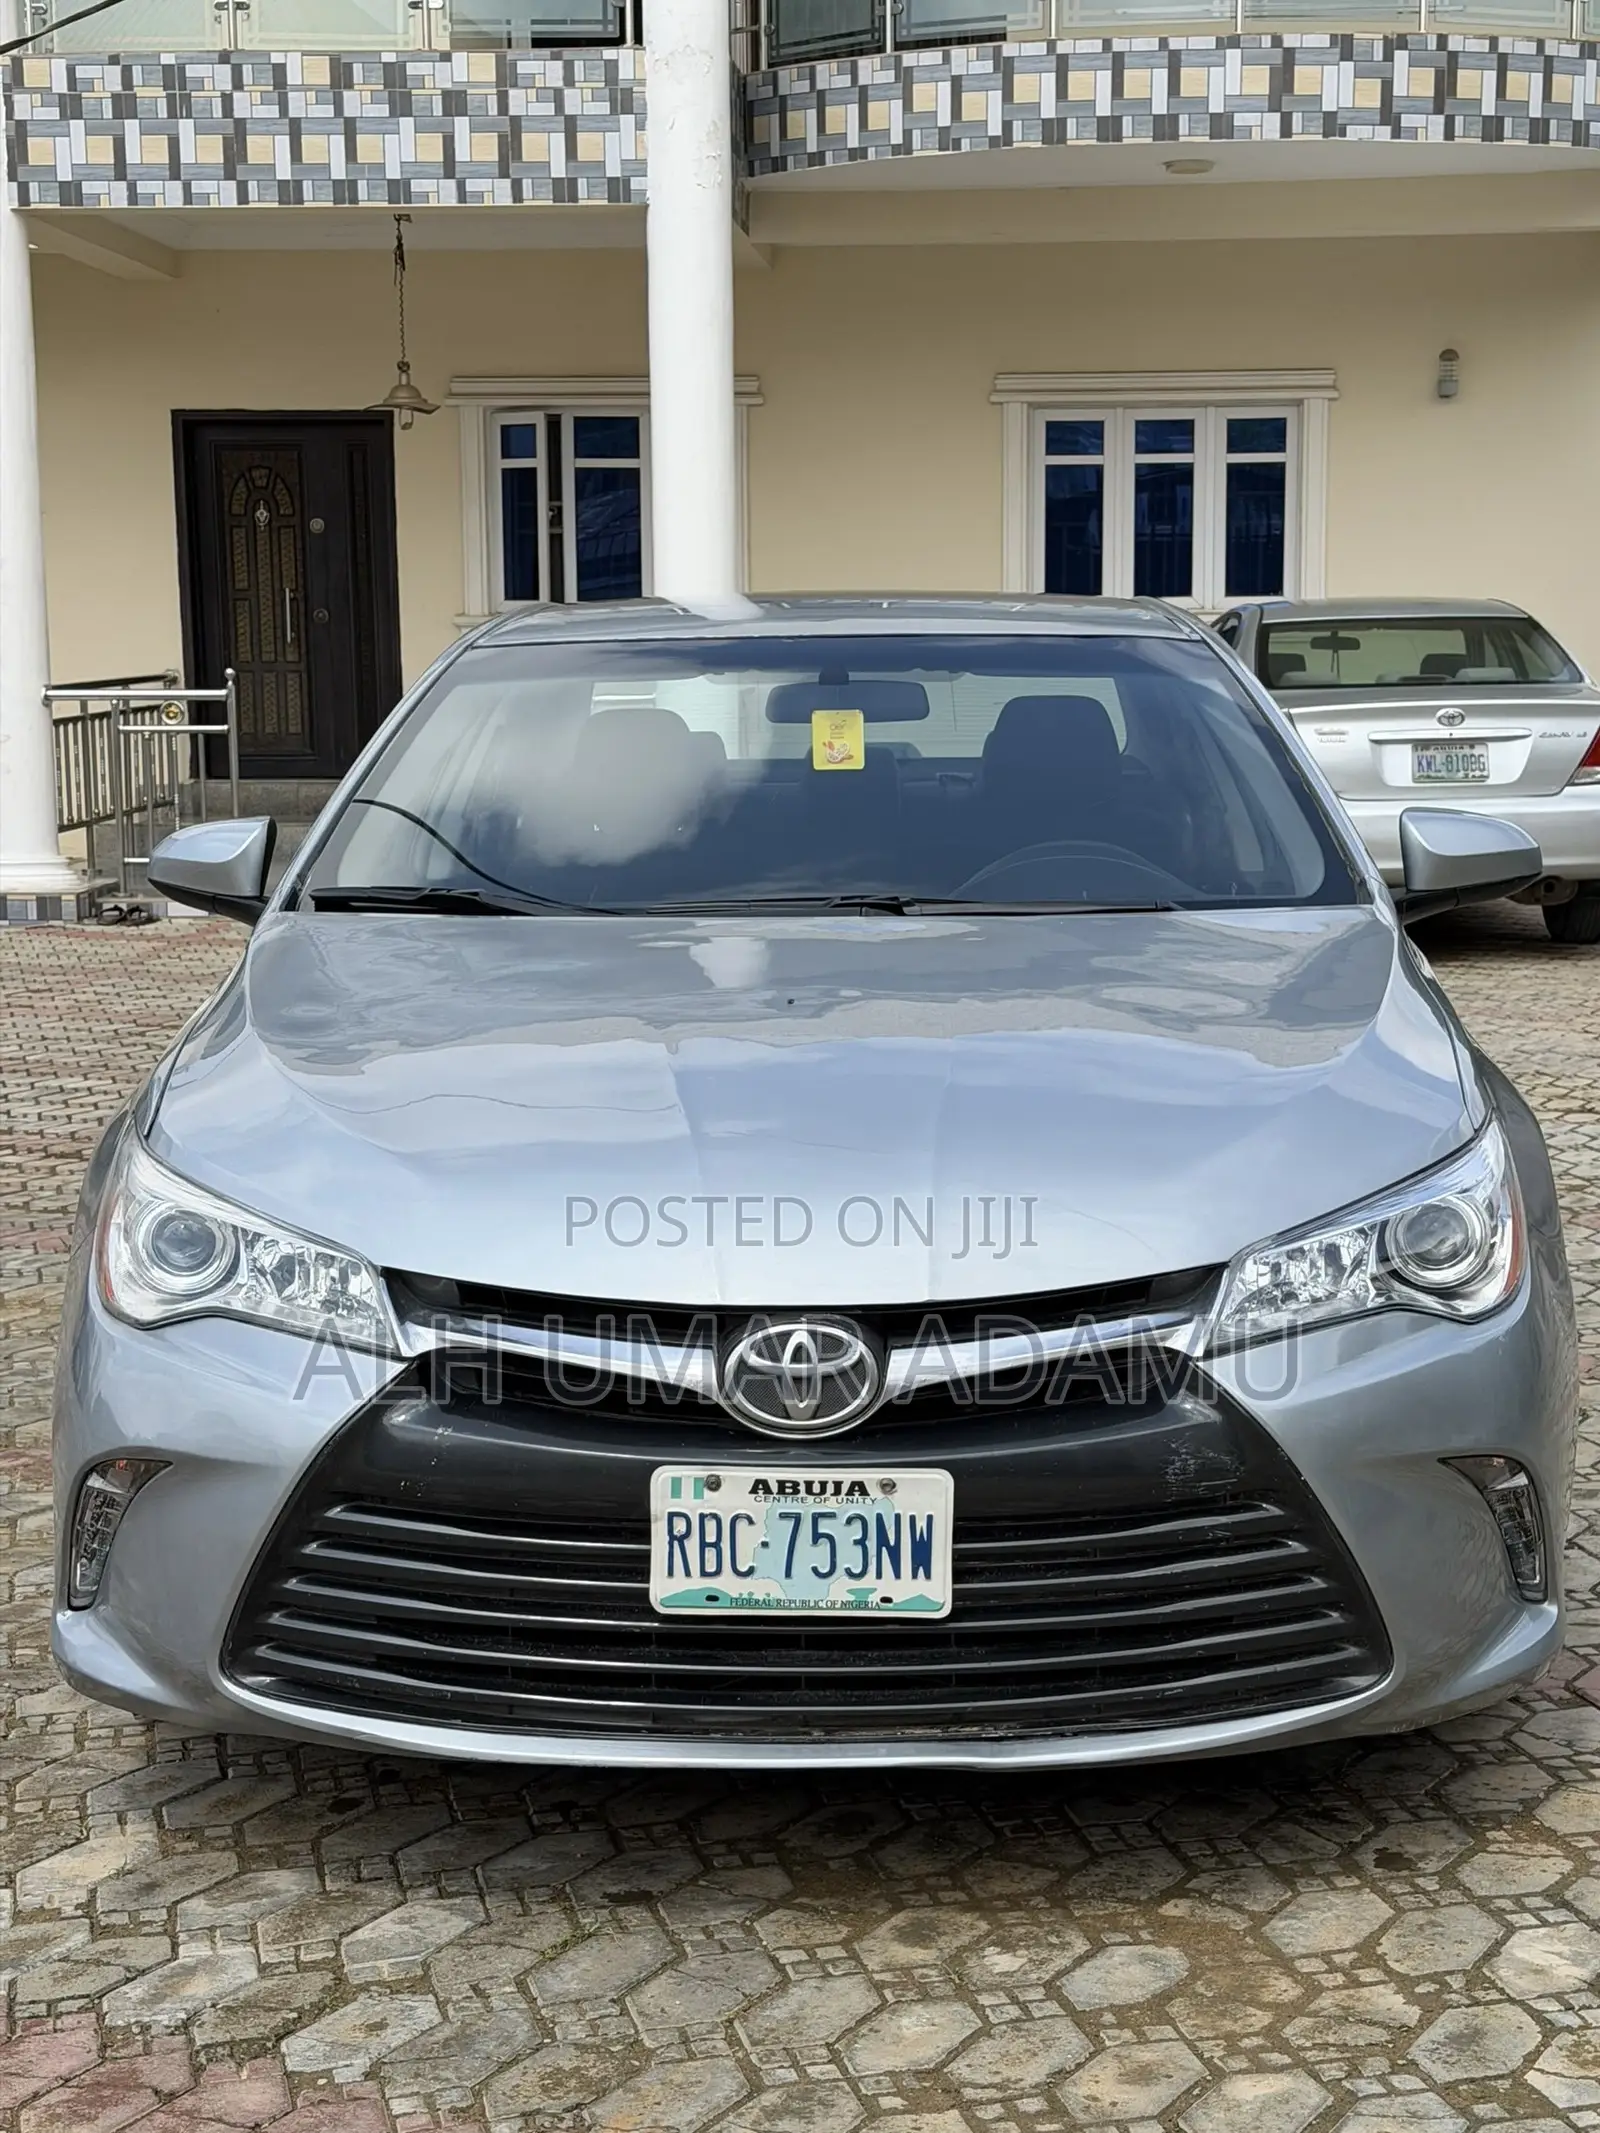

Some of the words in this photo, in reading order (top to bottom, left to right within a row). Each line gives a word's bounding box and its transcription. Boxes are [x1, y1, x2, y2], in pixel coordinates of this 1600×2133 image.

[748, 1478, 870, 1497] ABUJA
[754, 1495, 808, 1503] CENTRE
[813, 1496, 831, 1505] OF
[835, 1497, 877, 1505] UNITY
[730, 1597, 774, 1608] FEDERAL
[776, 1598, 824, 1609] REPUBLIC
[825, 1599, 839, 1609] OF
[841, 1599, 881, 1610] NIGERIA
